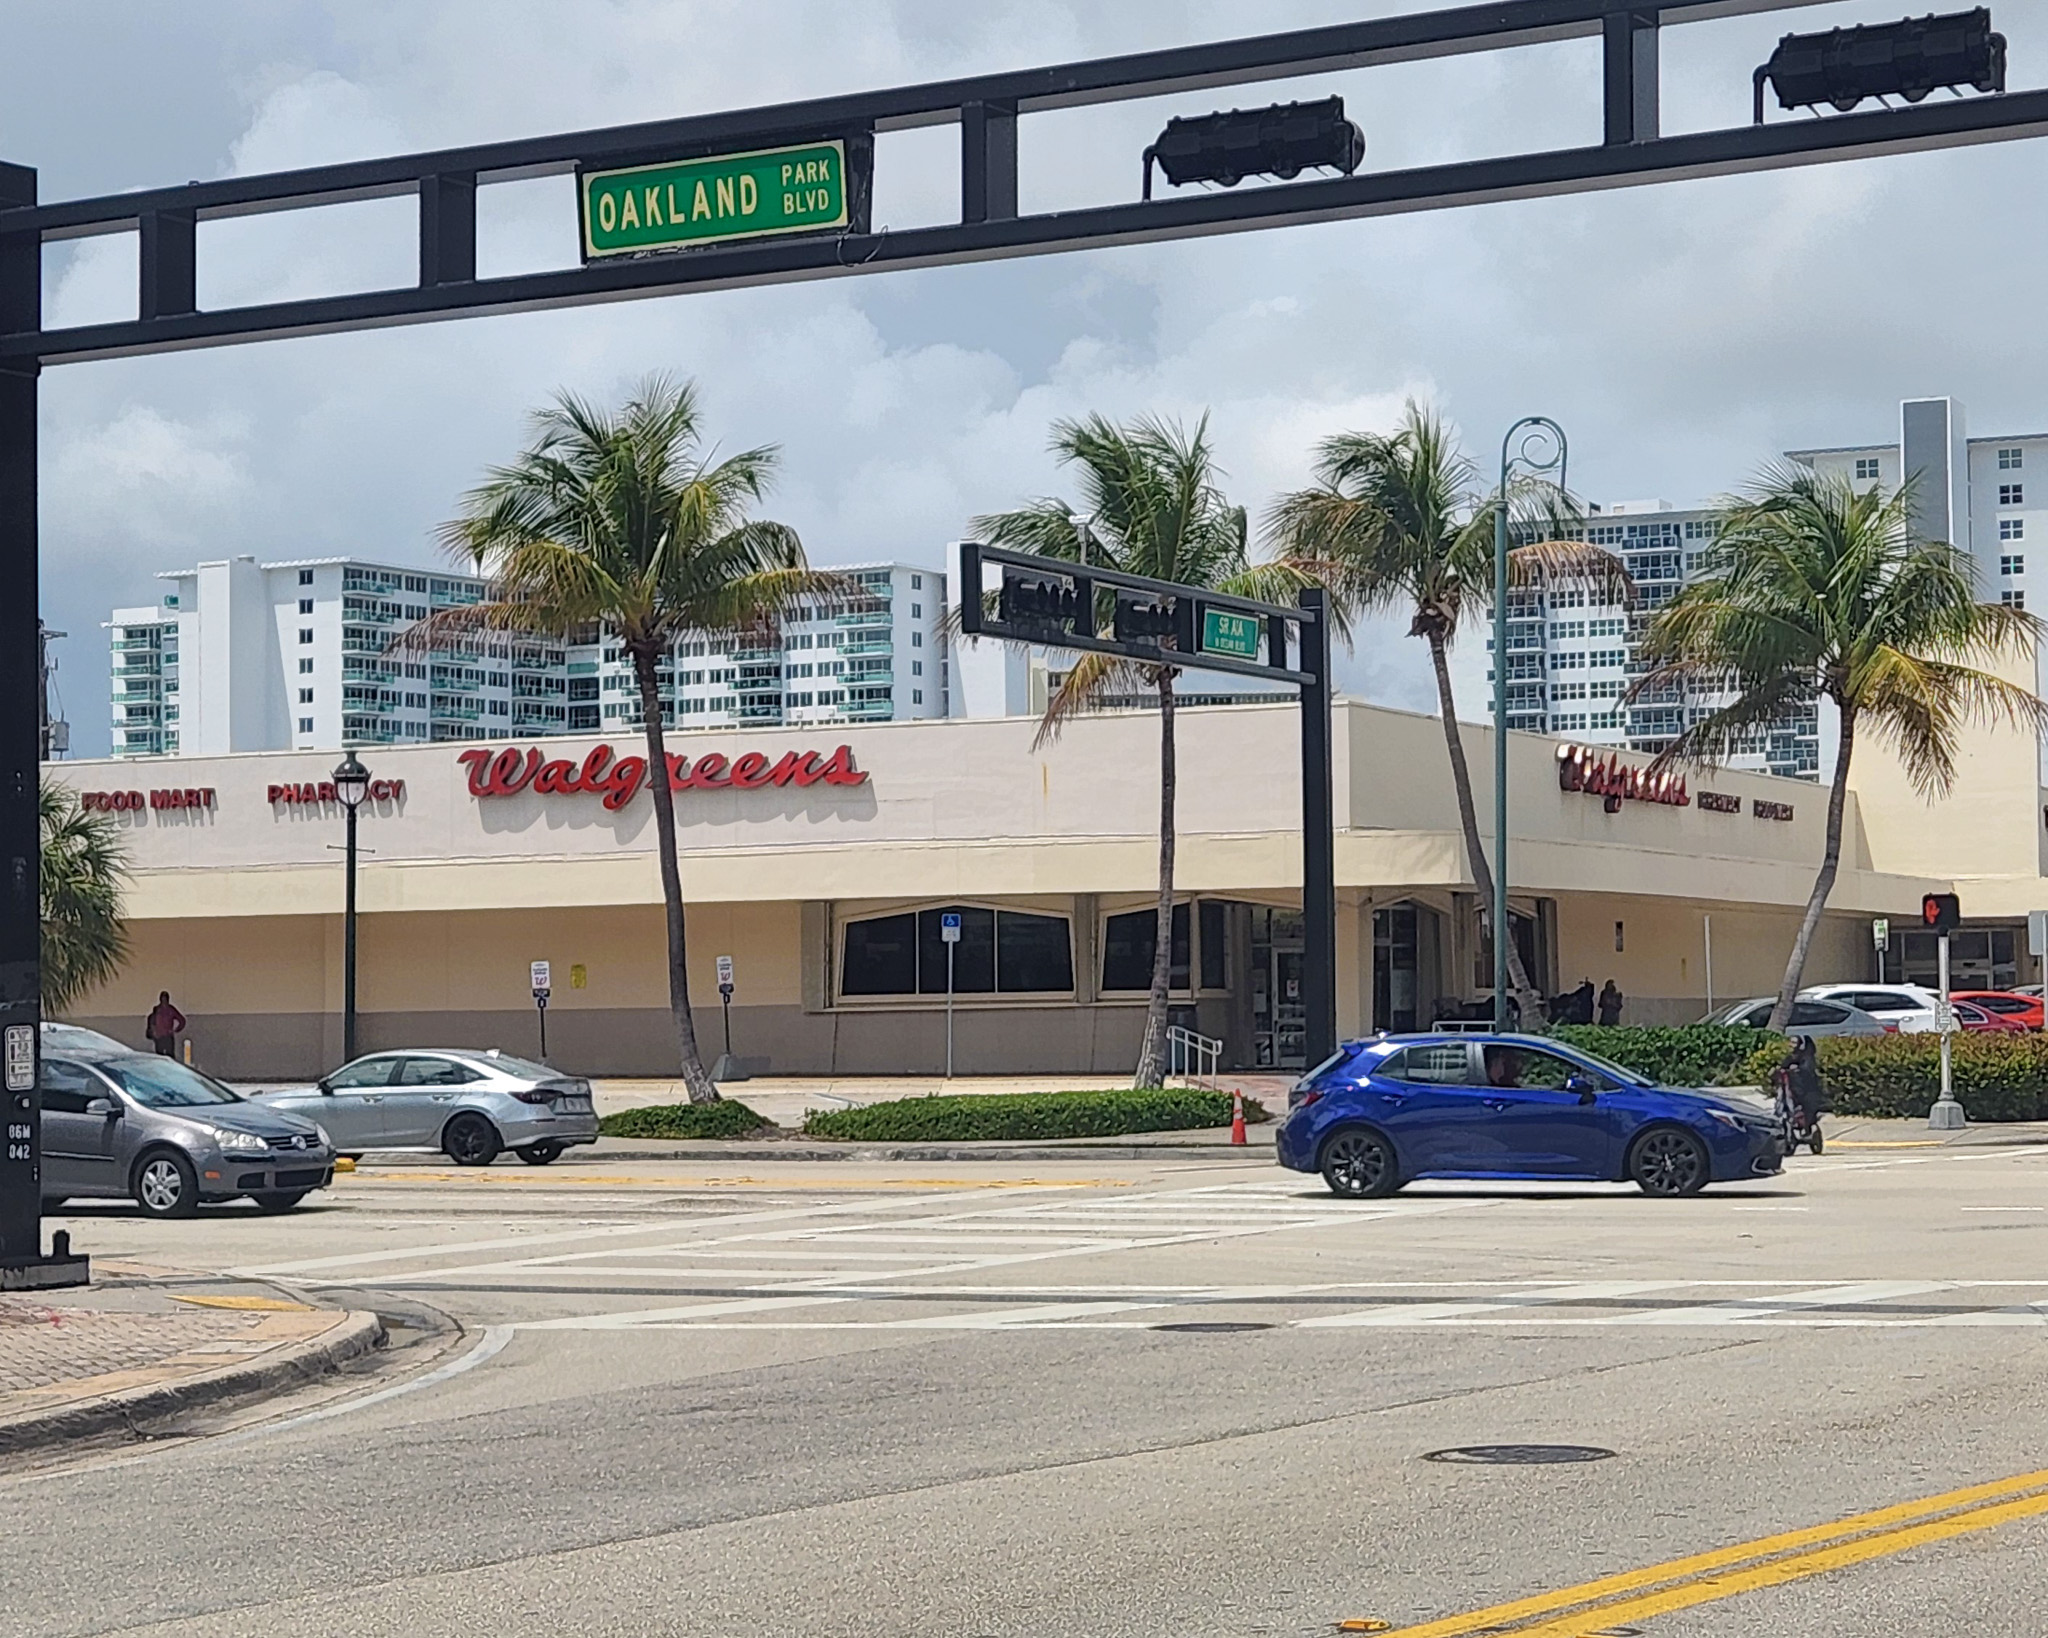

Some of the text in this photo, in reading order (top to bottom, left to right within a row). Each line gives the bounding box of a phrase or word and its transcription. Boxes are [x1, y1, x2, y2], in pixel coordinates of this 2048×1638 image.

[781, 158, 831, 187] PARK
[599, 174, 758, 233] OAKLAND
[782, 188, 830, 216] BLVD
[267, 778, 405, 804] PHARCY
[457, 742, 871, 813] Walgreens
[81, 787, 215, 813] FOOD MART
